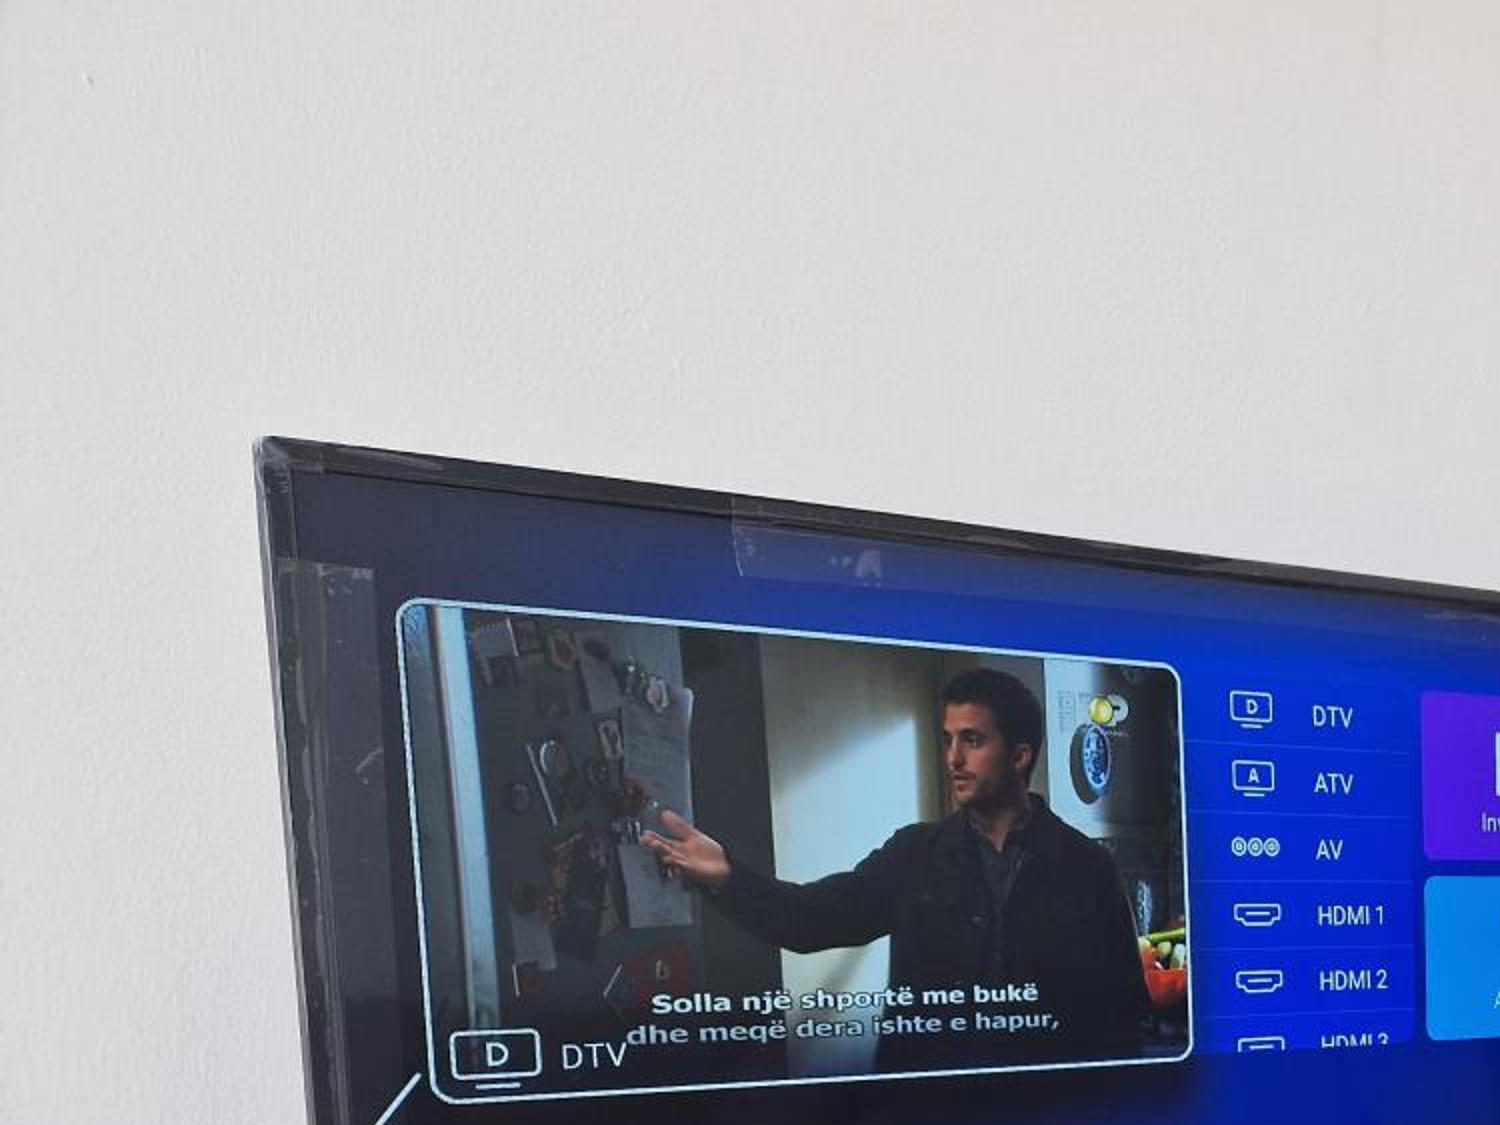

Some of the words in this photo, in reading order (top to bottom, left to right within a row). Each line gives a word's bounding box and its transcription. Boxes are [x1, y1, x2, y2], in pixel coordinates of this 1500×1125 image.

[1312, 704, 1353, 729] DTV
[1314, 772, 1353, 794] ATV
[1315, 840, 1343, 860] AV
[1318, 905, 1370, 926] HDMI
[1376, 906, 1385, 925] 1
[1319, 972, 1371, 991] HDMI
[1377, 970, 1388, 989] 2
[651, 993, 731, 1015] Solla
[743, 991, 791, 1014] një
[800, 987, 913, 1011] shportë
[923, 988, 965, 1005] me
[973, 983, 1038, 1003] bukë
[626, 1024, 689, 1045] dhe
[699, 1021, 787, 1043] meqë
[796, 1018, 864, 1037] dera
[872, 1015, 942, 1036] ishte
[951, 1016, 967, 1031] e
[974, 1012, 1059, 1033] hapur,
[562, 1042, 627, 1070] DTV
